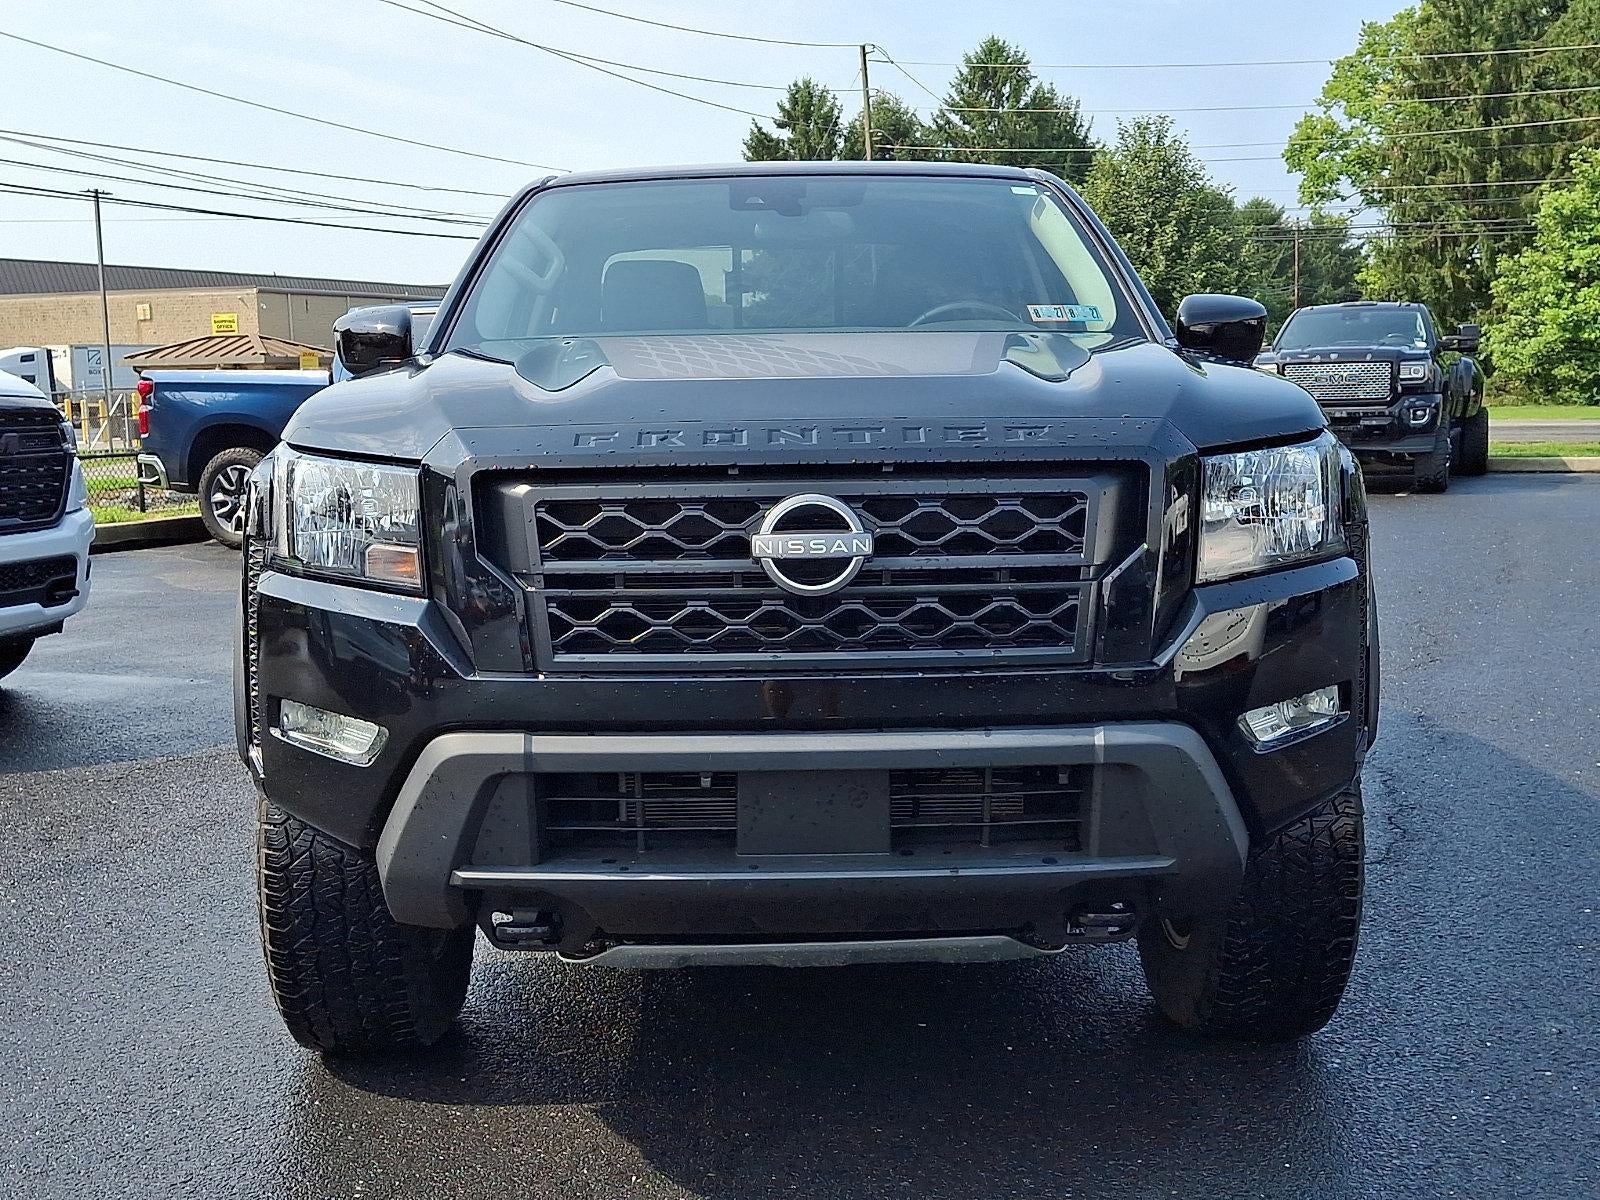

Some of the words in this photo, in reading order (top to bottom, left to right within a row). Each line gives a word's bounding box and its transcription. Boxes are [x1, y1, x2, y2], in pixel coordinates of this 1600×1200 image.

[1033, 308, 1042, 319] 8
[1053, 307, 1064, 319] 27
[1068, 308, 1077, 319] 8
[1088, 307, 1100, 319] 27
[1315, 373, 1359, 384] GMC
[572, 424, 1053, 447] FRONTIER
[754, 538, 870, 555] NISSAN
